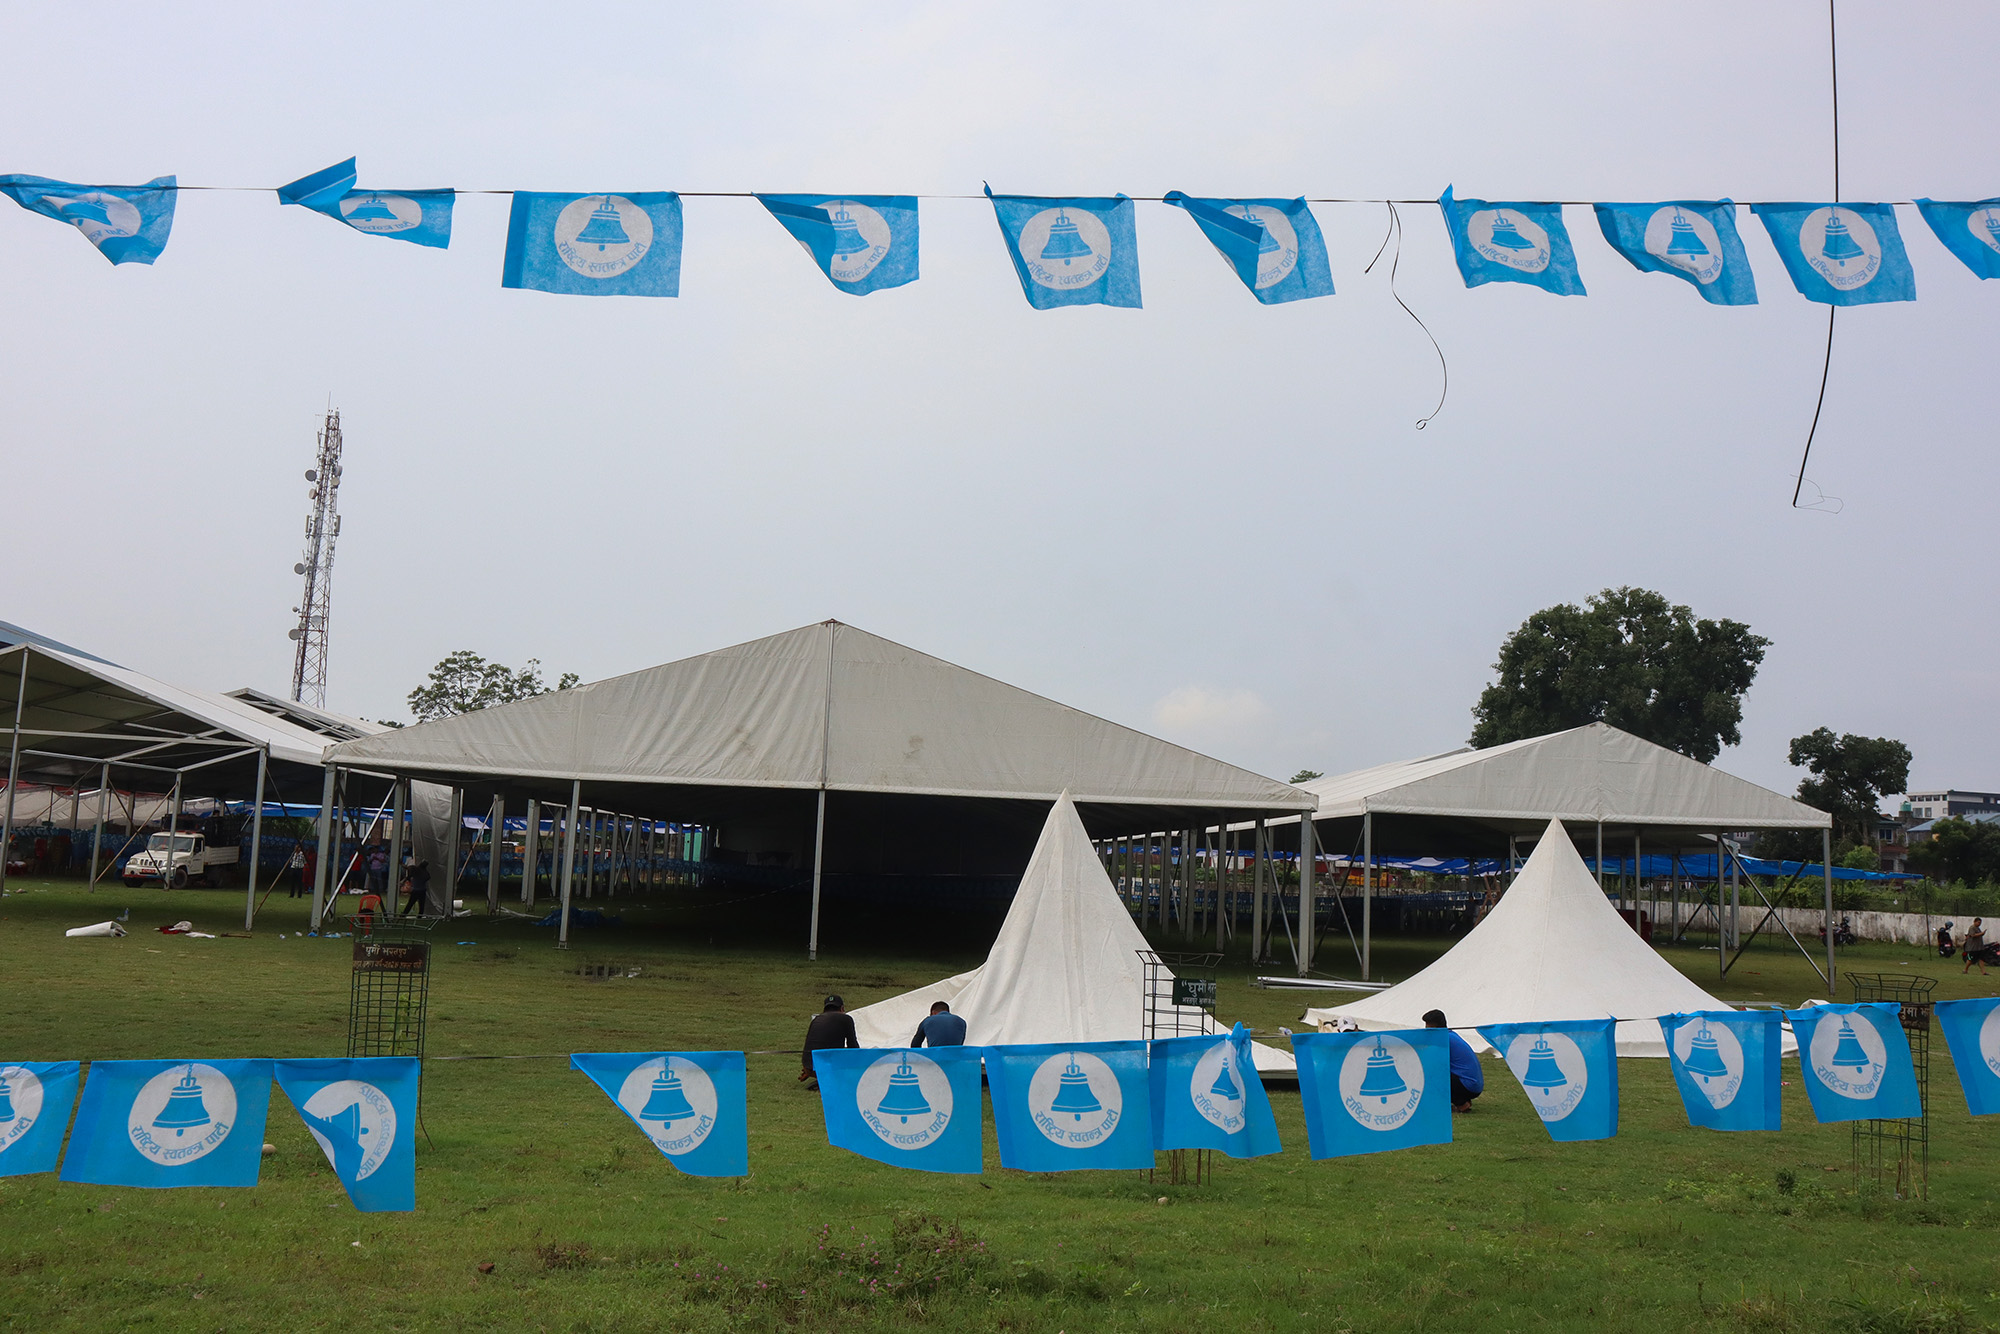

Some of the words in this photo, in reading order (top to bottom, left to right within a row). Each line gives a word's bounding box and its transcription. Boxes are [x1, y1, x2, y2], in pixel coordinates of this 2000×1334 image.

[1817, 1065, 1850, 1091] राष्ट्रिय
[1194, 1092, 1222, 1120] राष्ट्रिय
[1346, 1095, 1372, 1123] राष्ट्रिय
[1374, 1107, 1408, 1126] स्वतन्त्र
[1406, 1088, 1420, 1110] पार्टी
[131, 1125, 162, 1155] राष्ट्रिय
[163, 1140, 205, 1160] स्वतन्त्र
[205, 1121, 229, 1145] पार्टी
[693, 1114, 713, 1138] पार्टी
[862, 1109, 891, 1139] राष्ट्रिय
[893, 1129, 930, 1145] स्वतन्त्र
[929, 1110, 949, 1134] पार्टी
[1034, 1110, 1066, 1139] राष्ट्रिय
[1068, 1126, 1103, 1143] स्वतन्त्र
[1101, 1108, 1119, 1131] पार्टी
